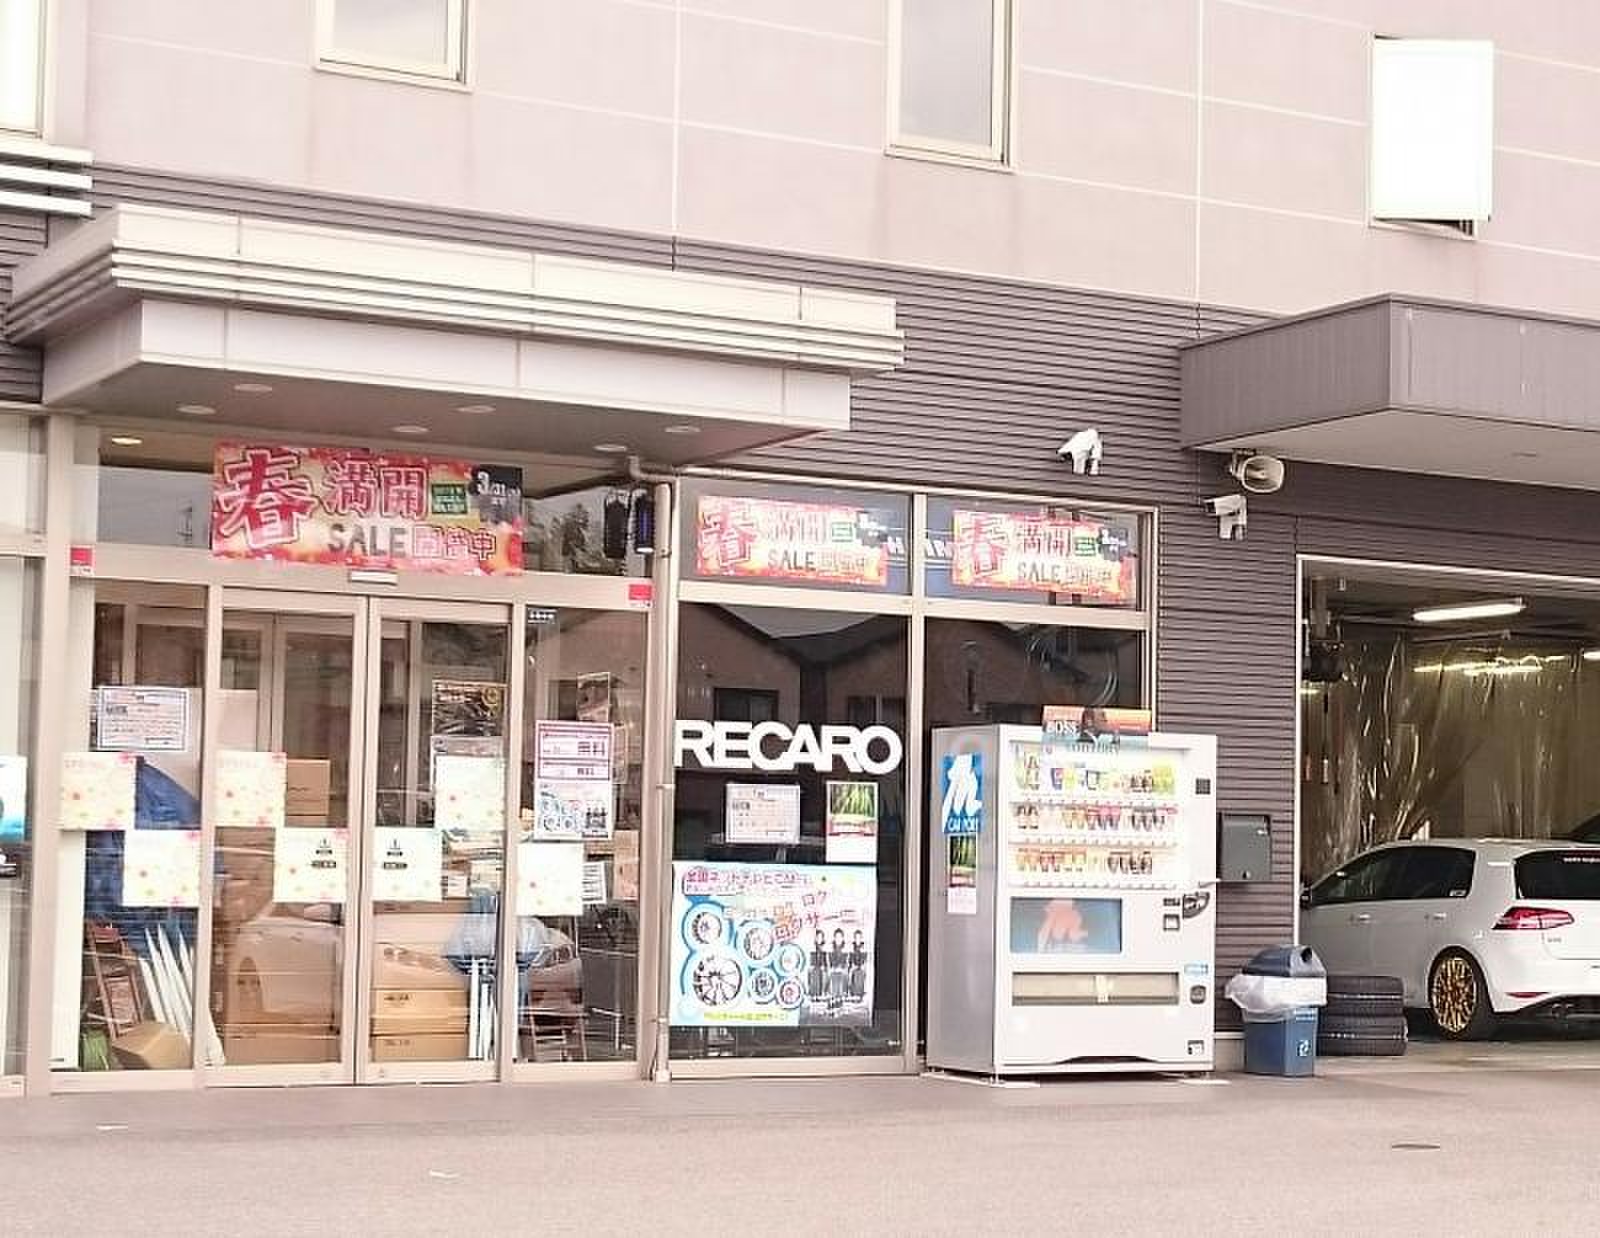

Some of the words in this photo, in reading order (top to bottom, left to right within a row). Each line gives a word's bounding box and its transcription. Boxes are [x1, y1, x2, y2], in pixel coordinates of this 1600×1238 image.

[328, 523, 407, 557] SALE
[767, 547, 815, 571] SALE
[1017, 559, 1061, 583] SALE
[675, 720, 903, 775] RECARO
